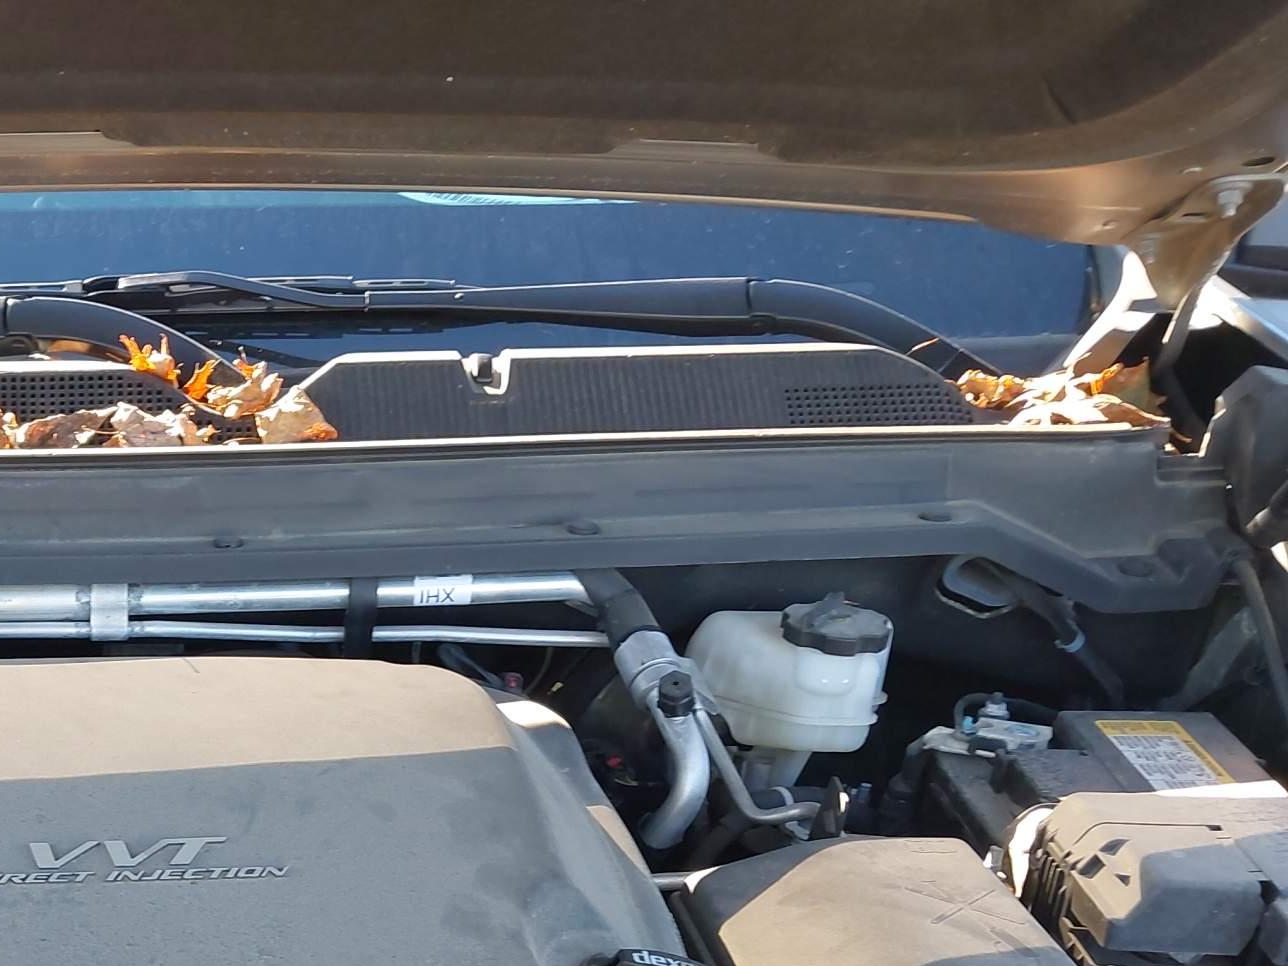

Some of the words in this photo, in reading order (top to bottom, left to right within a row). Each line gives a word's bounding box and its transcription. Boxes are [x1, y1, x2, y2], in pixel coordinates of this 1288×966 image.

[420, 587, 455, 603] IHX
[29, 837, 227, 869] VVT
[105, 866, 289, 882] INJECTION
